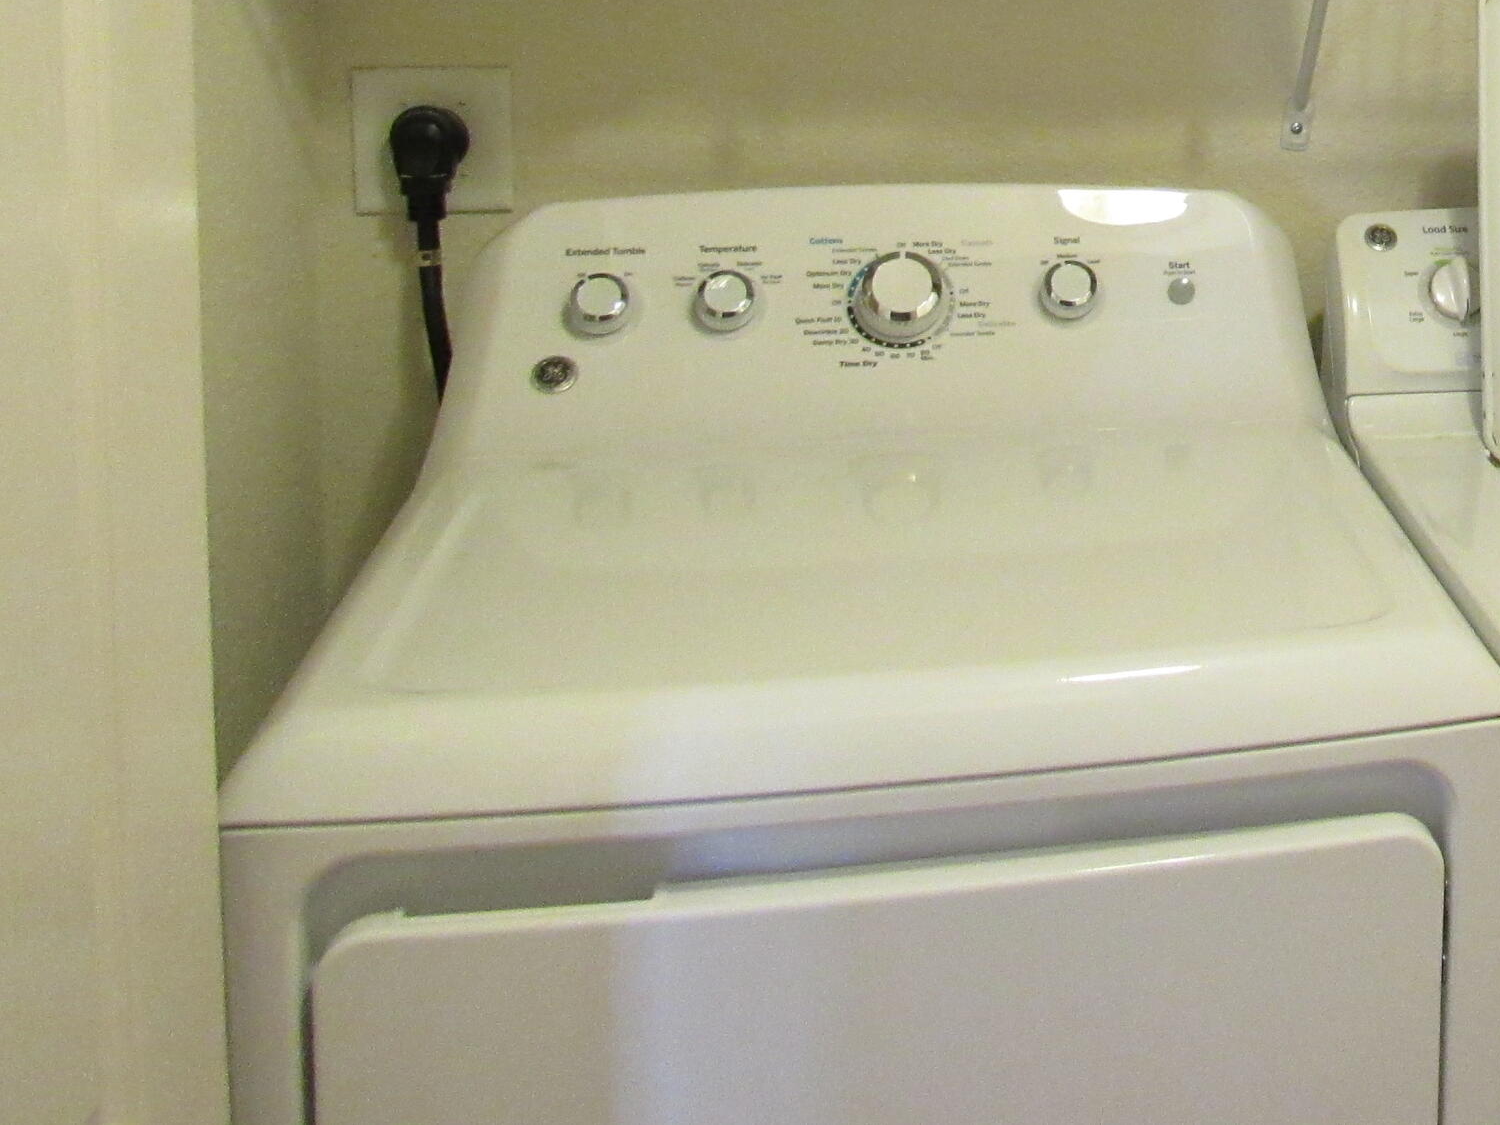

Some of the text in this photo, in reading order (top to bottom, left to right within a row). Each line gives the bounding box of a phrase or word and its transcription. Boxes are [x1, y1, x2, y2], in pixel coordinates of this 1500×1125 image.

[1053, 236, 1081, 246] Signal
[565, 247, 646, 257] Extended Tumble
[699, 244, 758, 255] Temperature
[1168, 261, 1191, 269] Start
[839, 360, 879, 368] Time Dry
